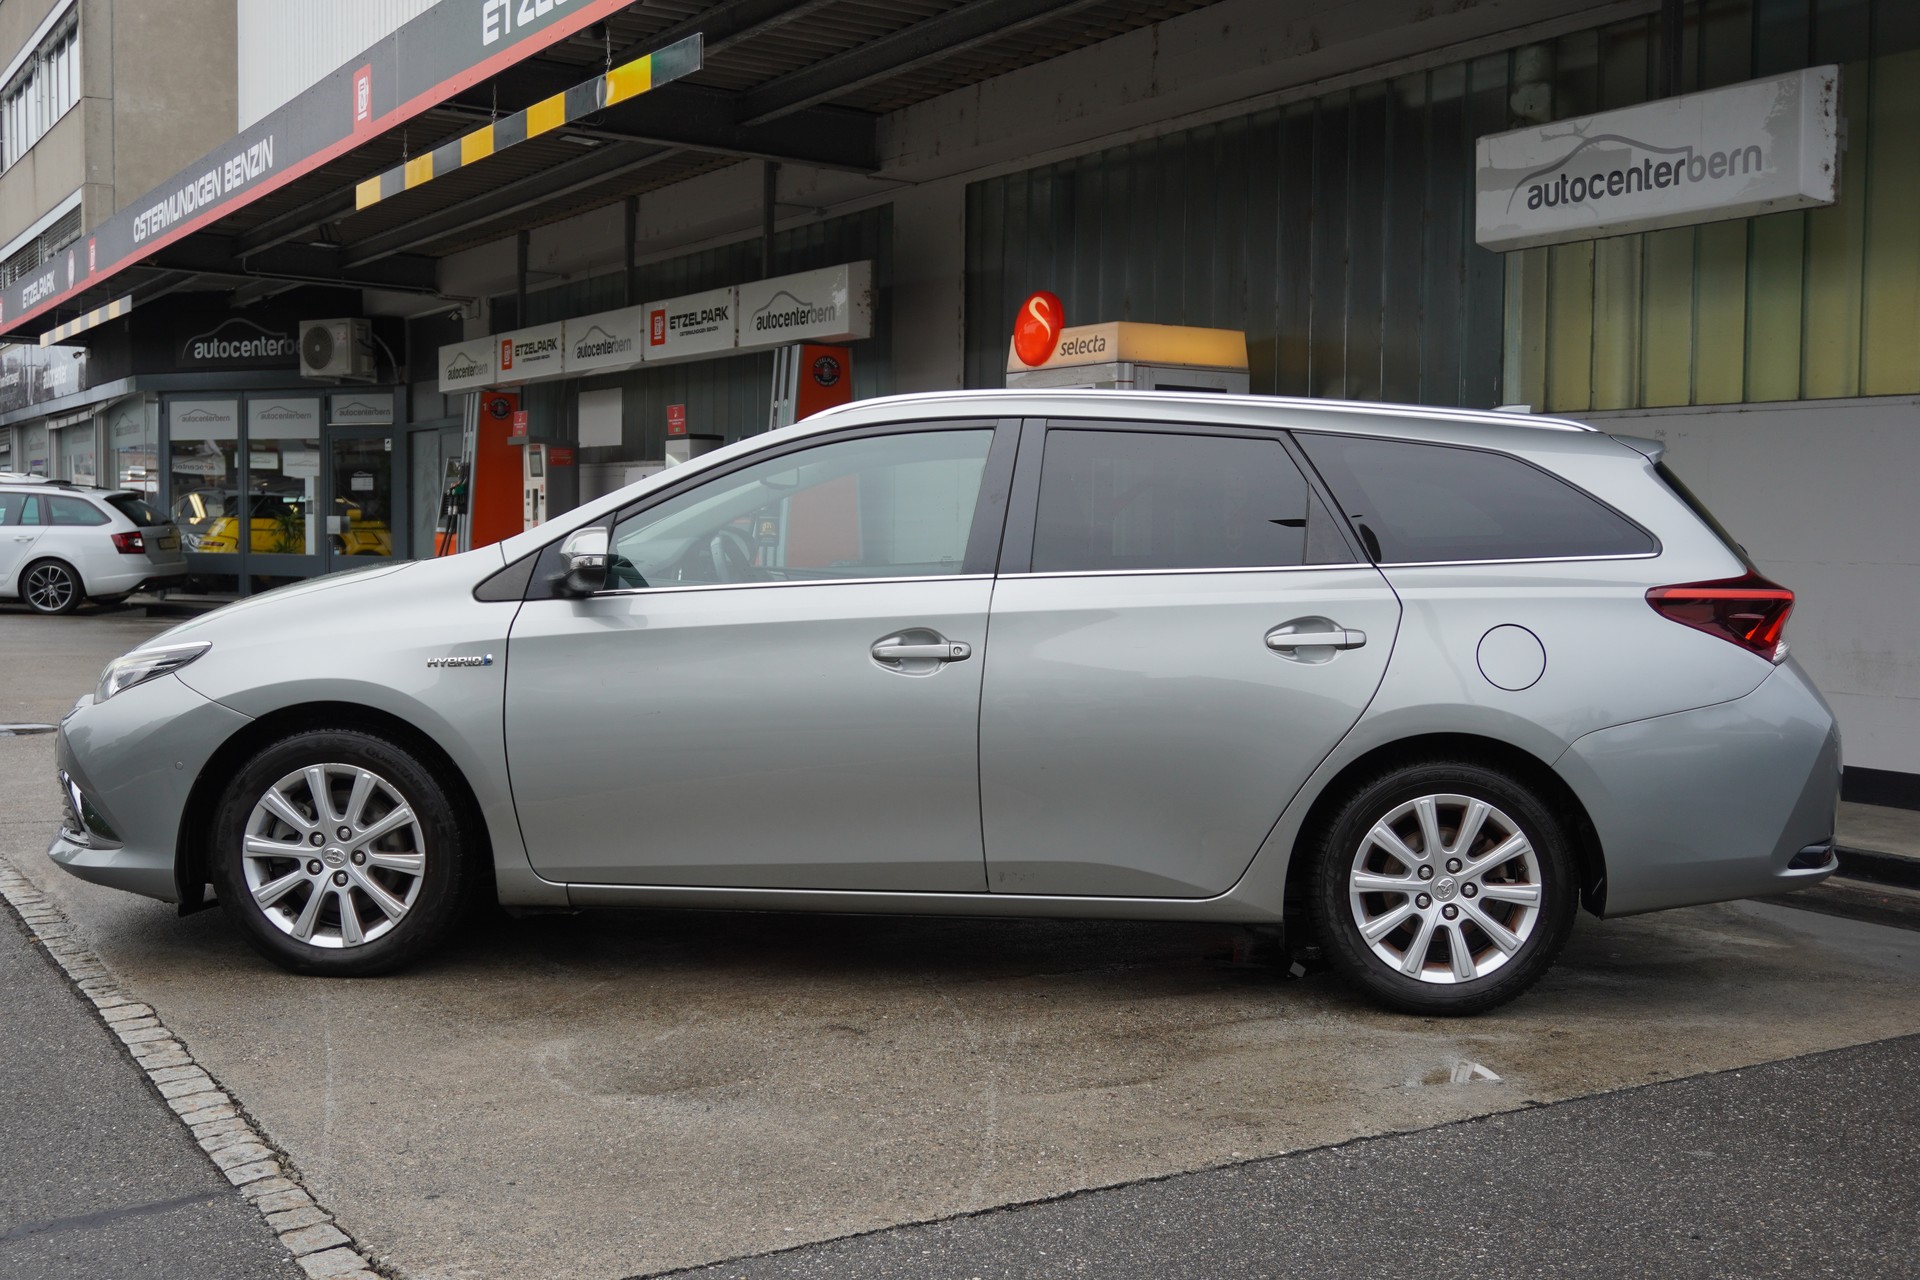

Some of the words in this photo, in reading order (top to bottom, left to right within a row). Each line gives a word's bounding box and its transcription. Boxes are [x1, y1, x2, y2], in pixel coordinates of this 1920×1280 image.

[1527, 145, 1762, 210] autocenterbern
[133, 166, 221, 243] OSTERMUNDIGEN
[224, 135, 273, 193] BENZIN
[22, 270, 56, 309] ETZELPARK
[669, 306, 729, 330] ETZELPARK
[756, 305, 835, 331] autocenterbern
[514, 337, 558, 358] ETZELPARK
[577, 338, 632, 360] autocenterbern
[1060, 334, 1106, 356] selecta
[447, 362, 488, 381] autocenterbern
[181, 413, 231, 423] autocenterbern
[260, 410, 312, 421] autocenterbern
[338, 407, 391, 418] autocenterbern
[427, 656, 482, 667] HYBRID
